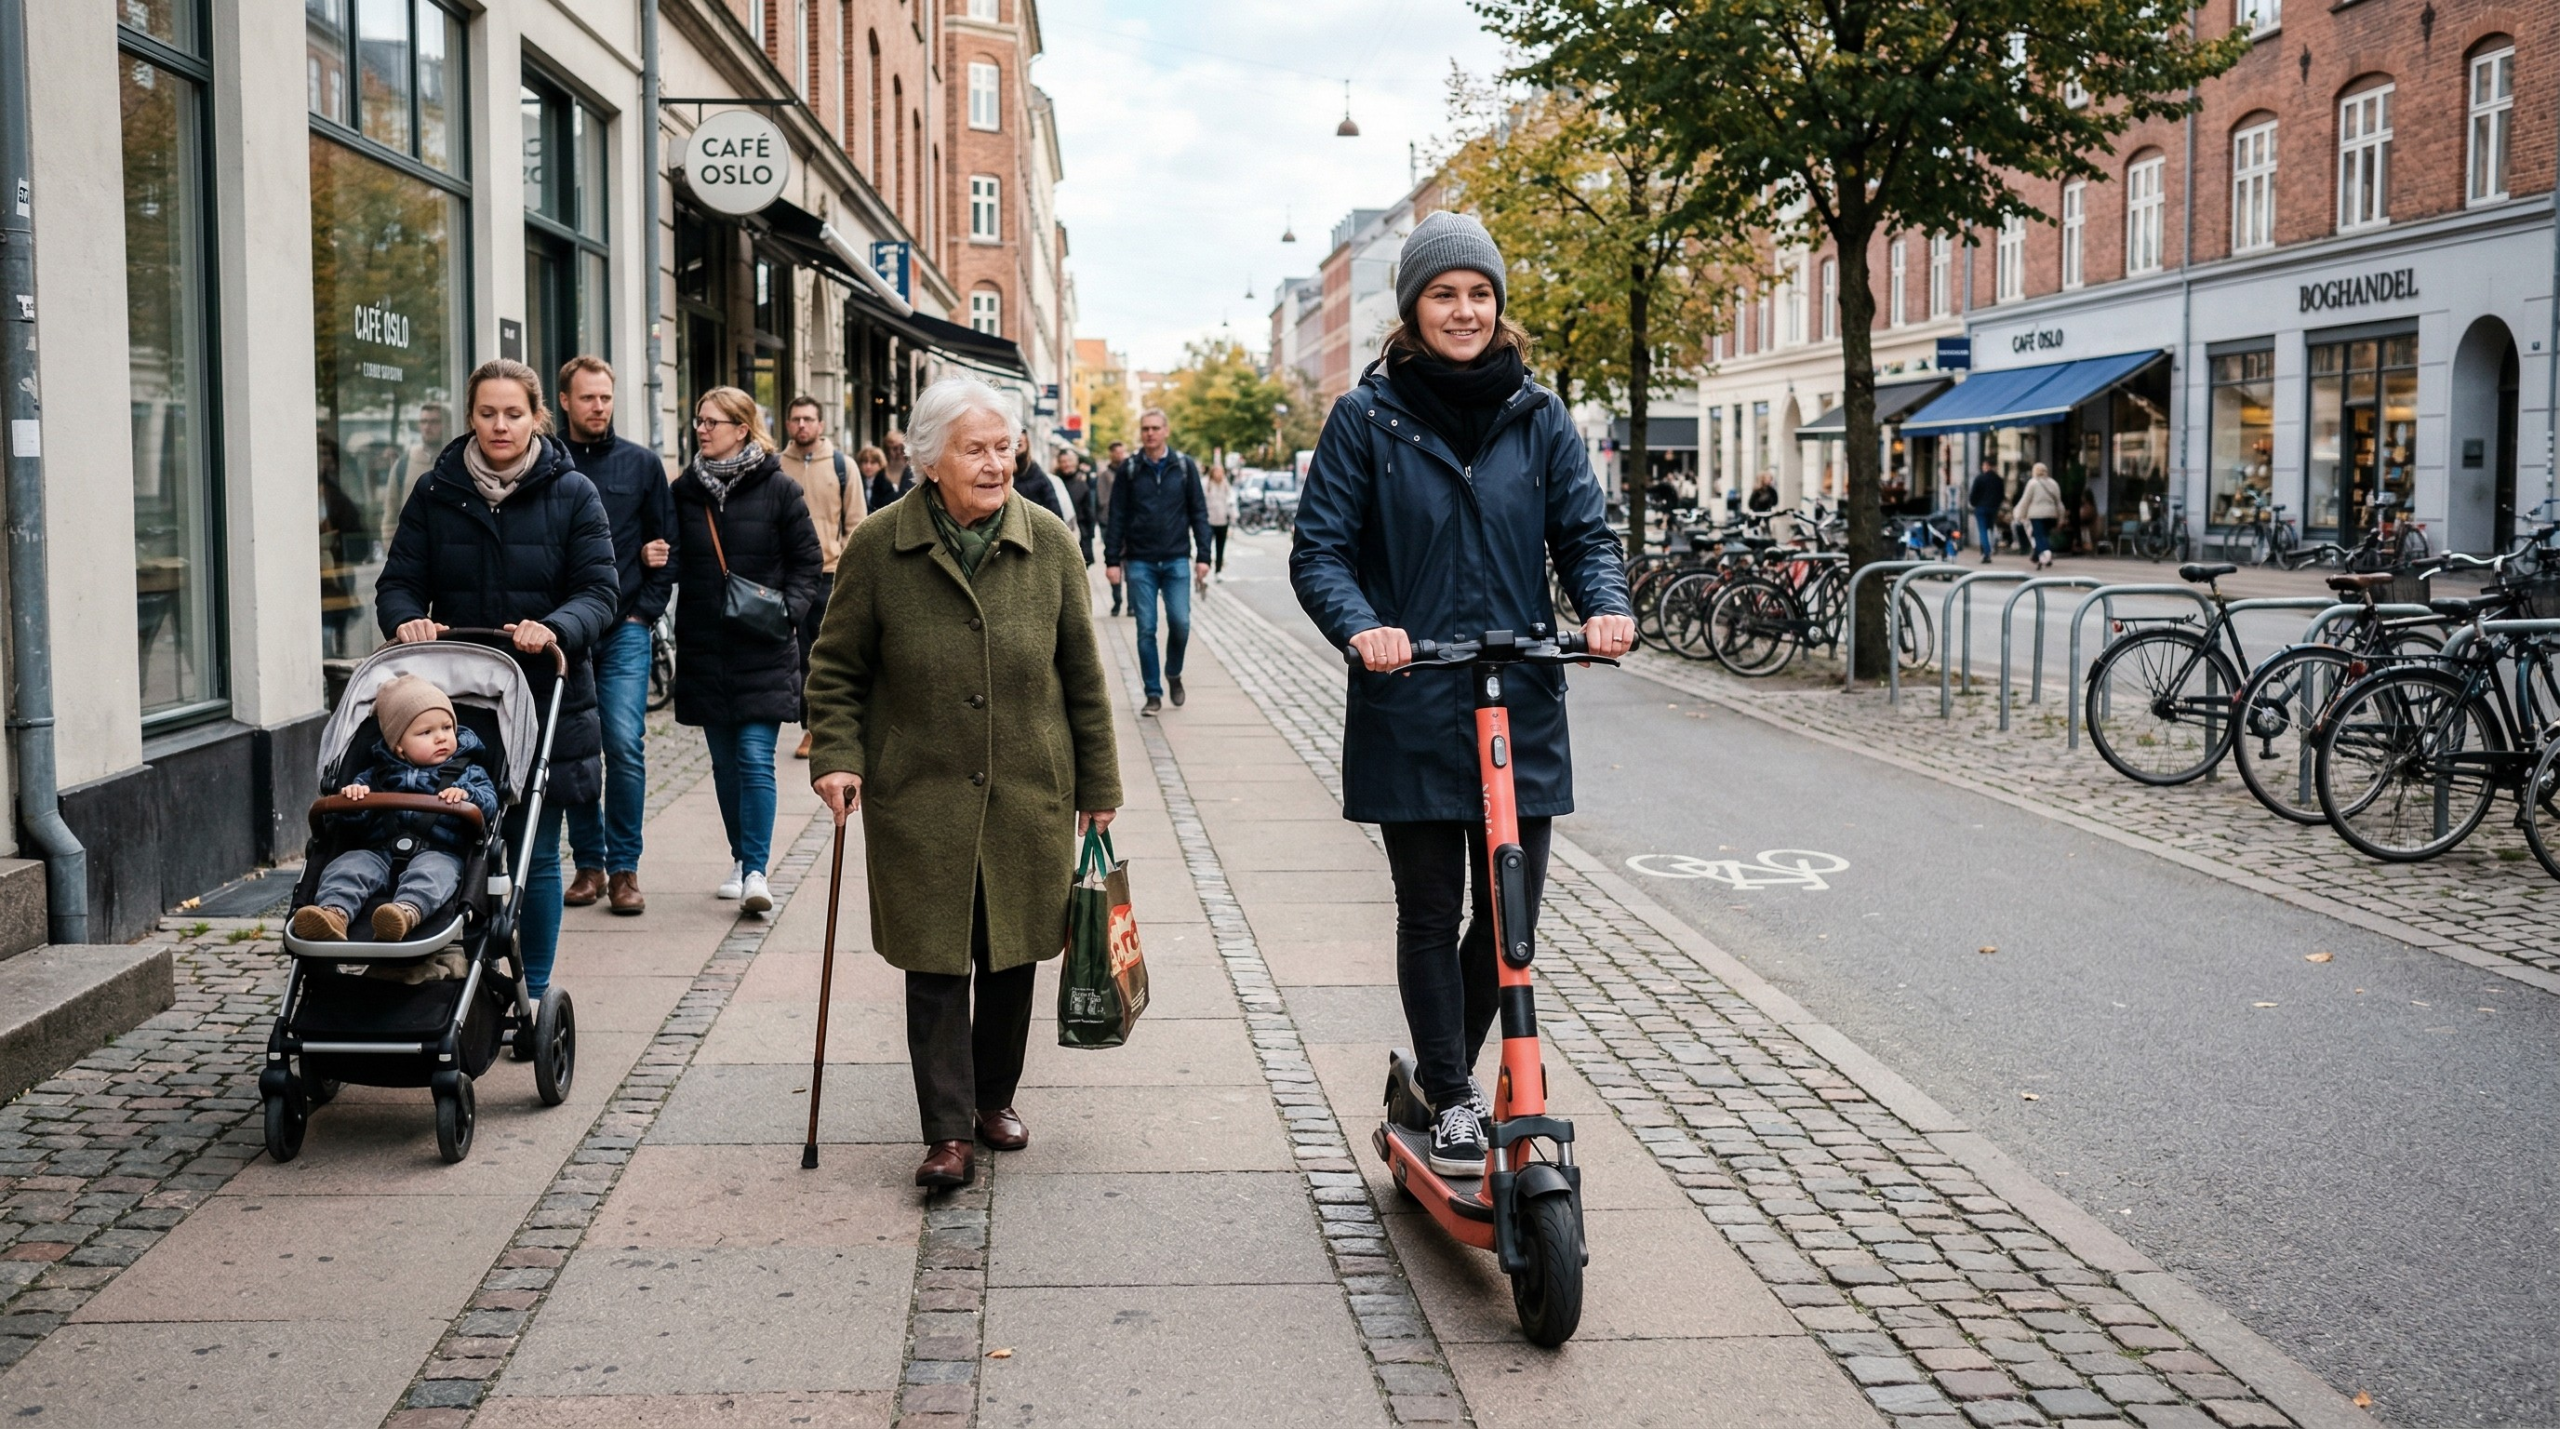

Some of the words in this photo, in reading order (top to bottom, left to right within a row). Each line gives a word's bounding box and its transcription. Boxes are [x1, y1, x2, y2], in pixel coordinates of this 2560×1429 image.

[701, 132, 770, 158] CAFÉ
[701, 164, 773, 185] OSLO
[2299, 267, 2419, 313] BOGHANDEL
[354, 300, 382, 344] CAFÉ
[383, 311, 409, 349] OSLO
[2038, 328, 2064, 349] OSLO
